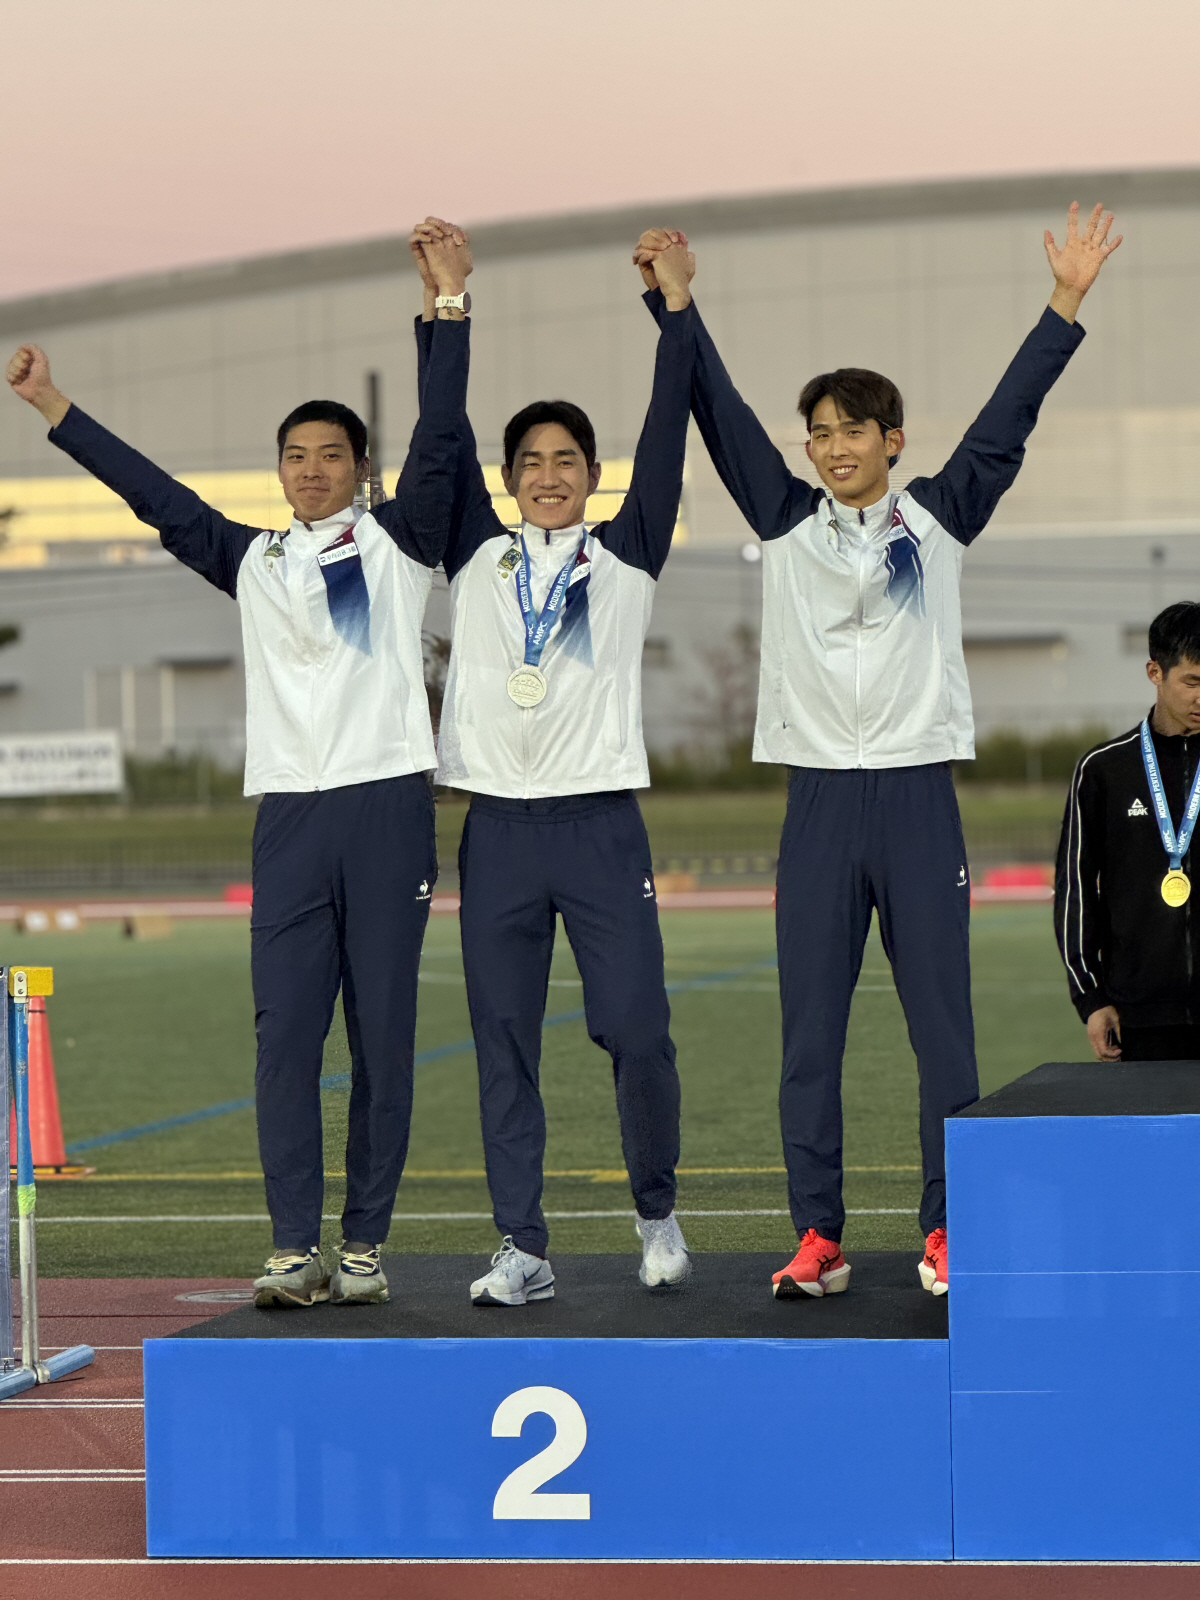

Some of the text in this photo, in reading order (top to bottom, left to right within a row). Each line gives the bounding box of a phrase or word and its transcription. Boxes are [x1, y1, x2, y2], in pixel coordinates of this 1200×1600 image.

[533, 621, 548, 645] AMPC
[547, 584, 563, 611] MODERN
[1127, 807, 1149, 817] PEAK
[1154, 792, 1167, 818] MODERN
[1187, 793, 1200, 819] MODERN
[1163, 829, 1174, 853] AMPC
[491, 1386, 591, 1520] 2
